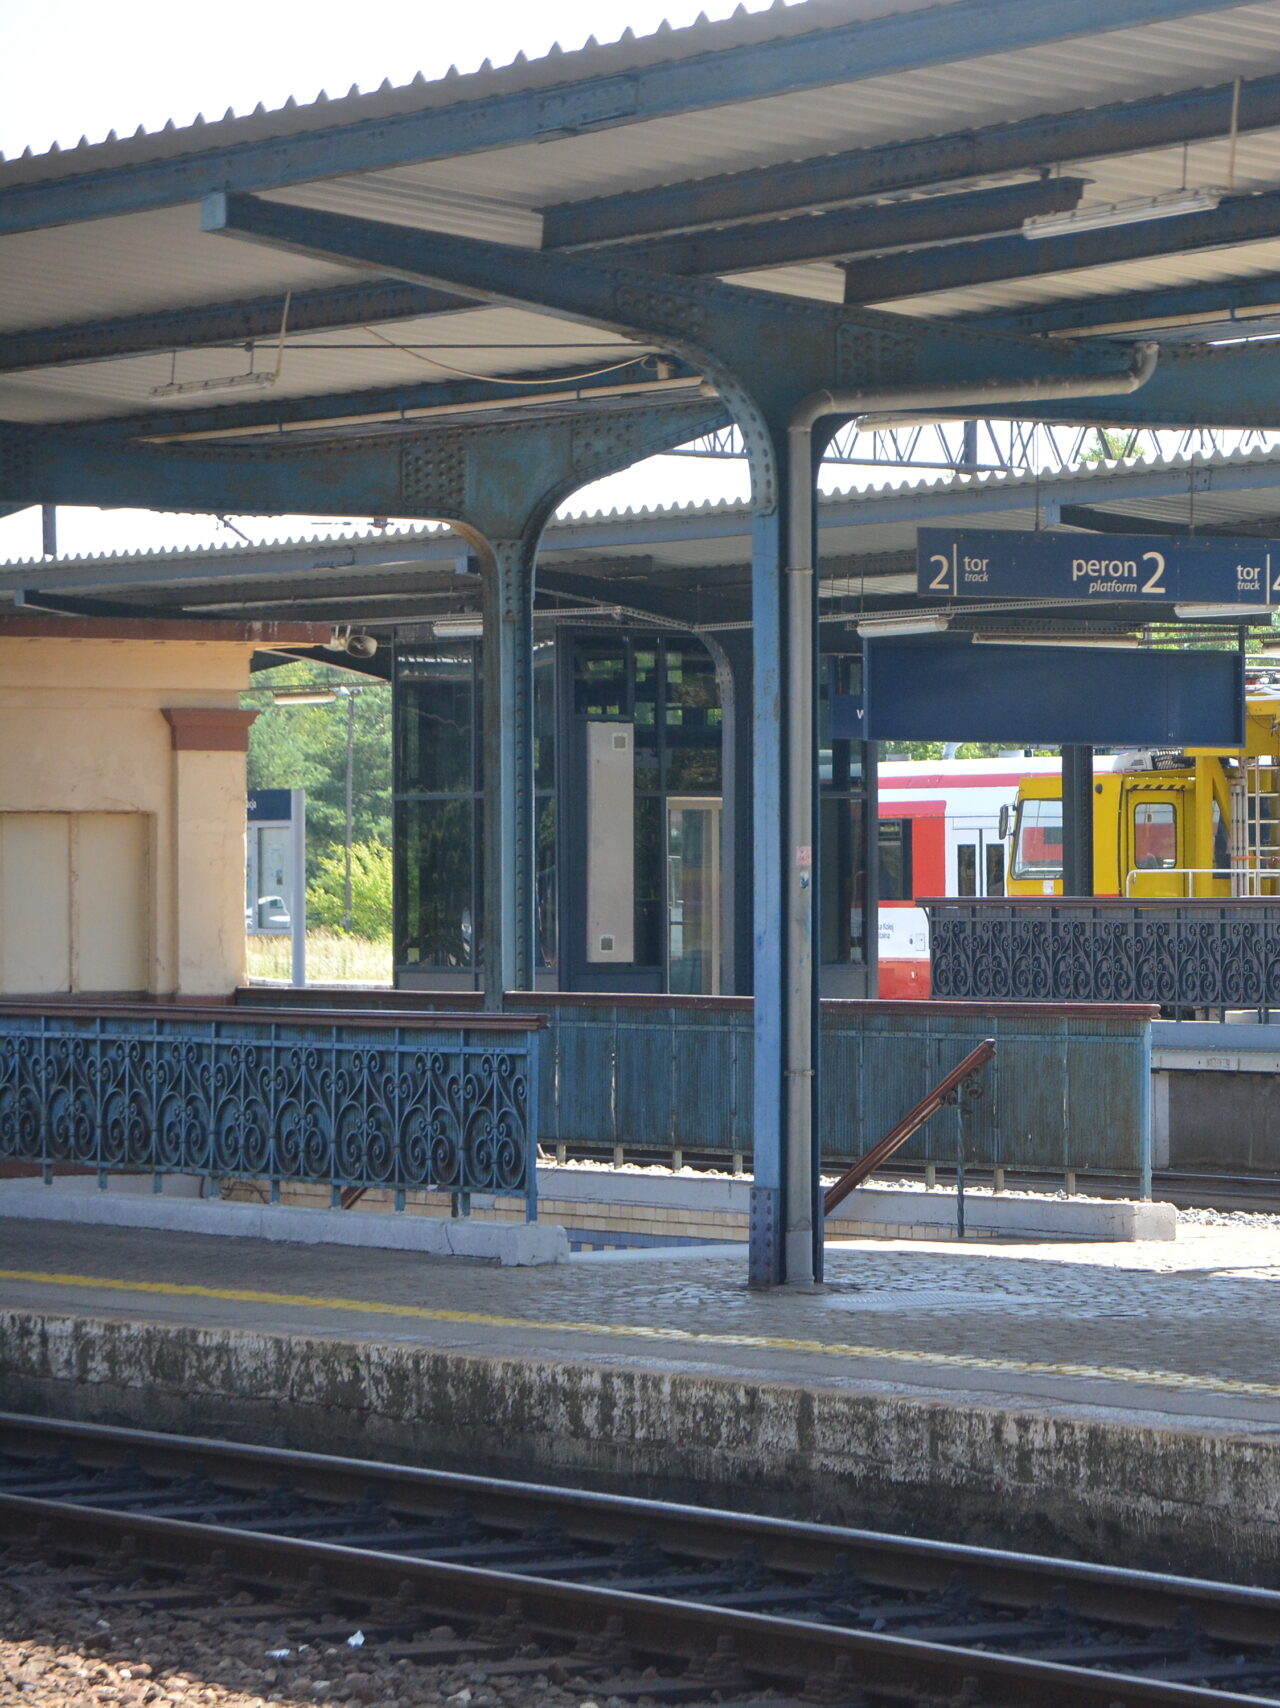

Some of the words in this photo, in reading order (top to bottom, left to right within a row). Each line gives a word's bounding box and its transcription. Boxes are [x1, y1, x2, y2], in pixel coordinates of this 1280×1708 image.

[928, 554, 950, 590] 2
[963, 555, 990, 572] tor
[963, 571, 990, 583] track
[1072, 558, 1138, 582] peron
[1141, 551, 1167, 594] 2
[1236, 564, 1261, 581] tor
[1088, 579, 1138, 595] platform
[1237, 579, 1261, 591] track
